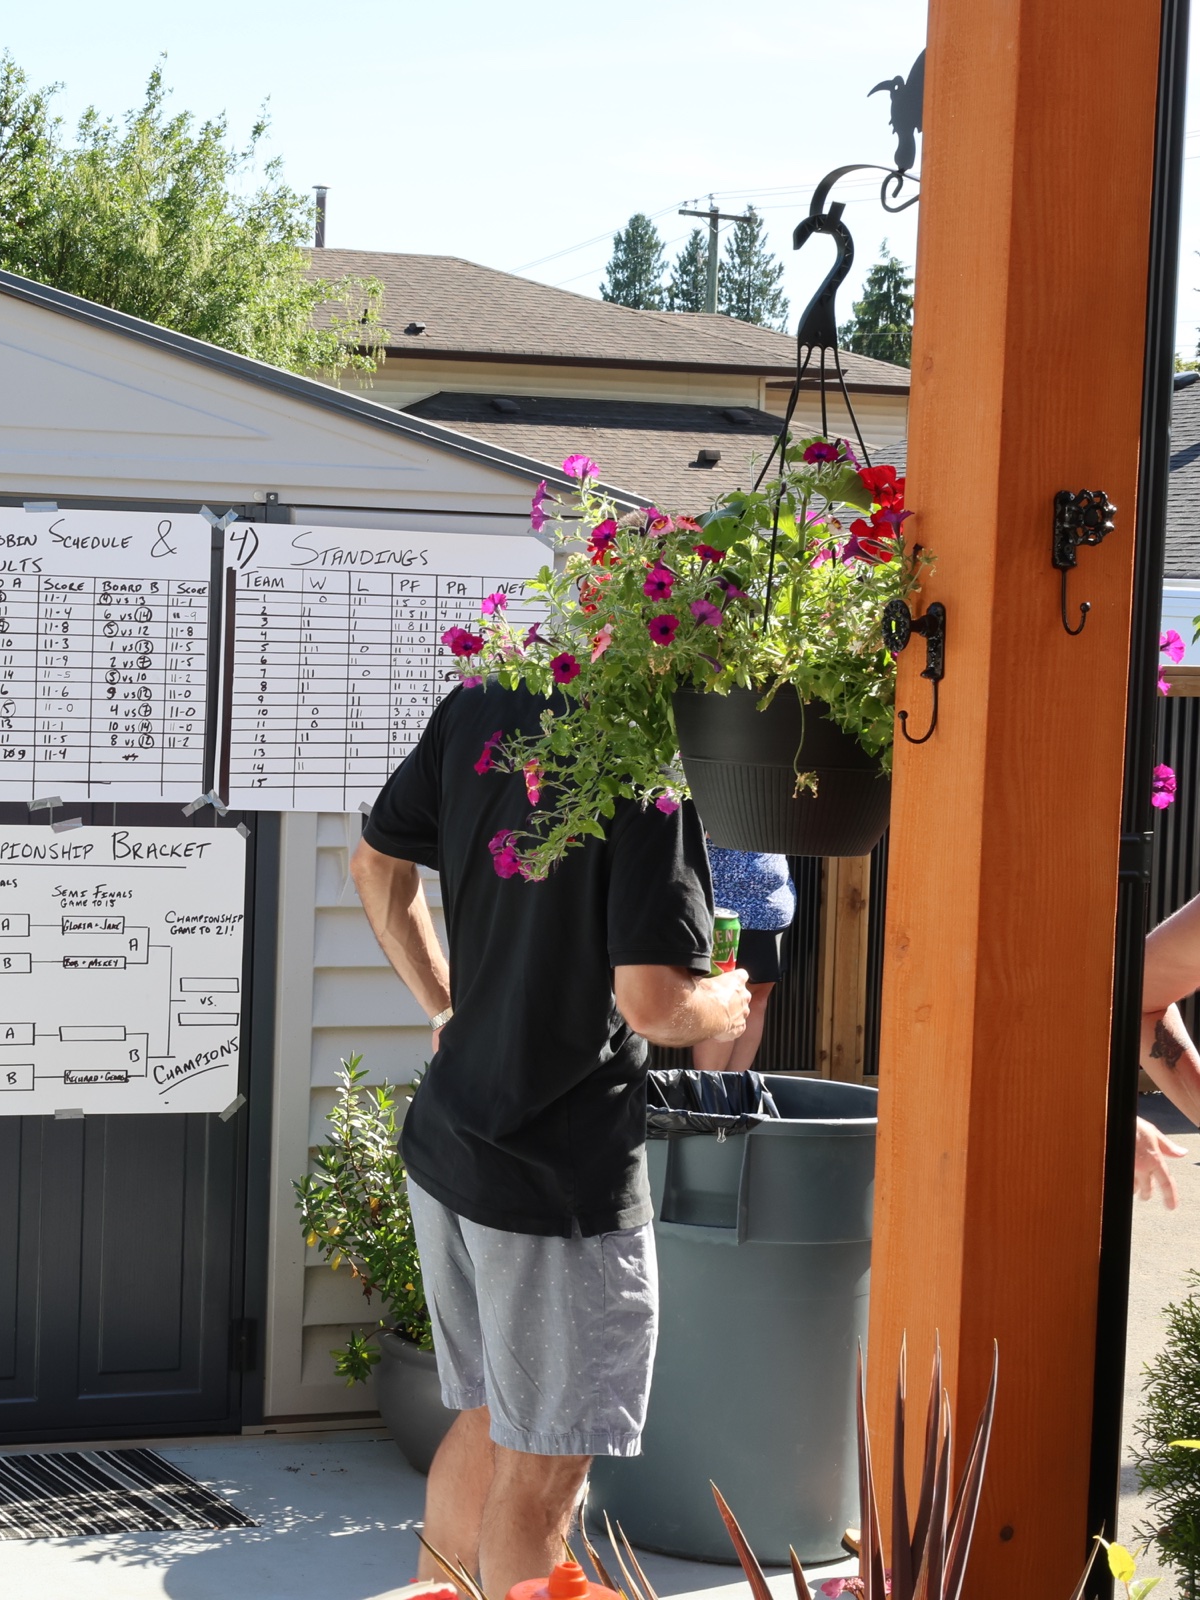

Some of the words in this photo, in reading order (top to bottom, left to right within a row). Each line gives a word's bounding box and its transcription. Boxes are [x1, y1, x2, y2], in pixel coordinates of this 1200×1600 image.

[48, 518, 133, 549] SCHEDULE
[150, 519, 178, 558] &
[290, 531, 429, 567] STANDINGS
[12, 576, 22, 588] A
[44, 580, 84, 591] SCORE
[240, 570, 285, 589] TEAM
[310, 576, 327, 589] W
[357, 579, 369, 592] L
[400, 579, 420, 592] PF
[103, 582, 142, 593] BOARD
[150, 582, 159, 593] B
[177, 583, 208, 595] SCORE
[447, 582, 467, 595] PA
[496, 584, 525, 594] NET
[251, 778, 267, 787] 15
[111, 831, 212, 861] BRACKET
[93, 883, 133, 899] FINALS
[153, 1036, 238, 1086] CHAMPIONS
